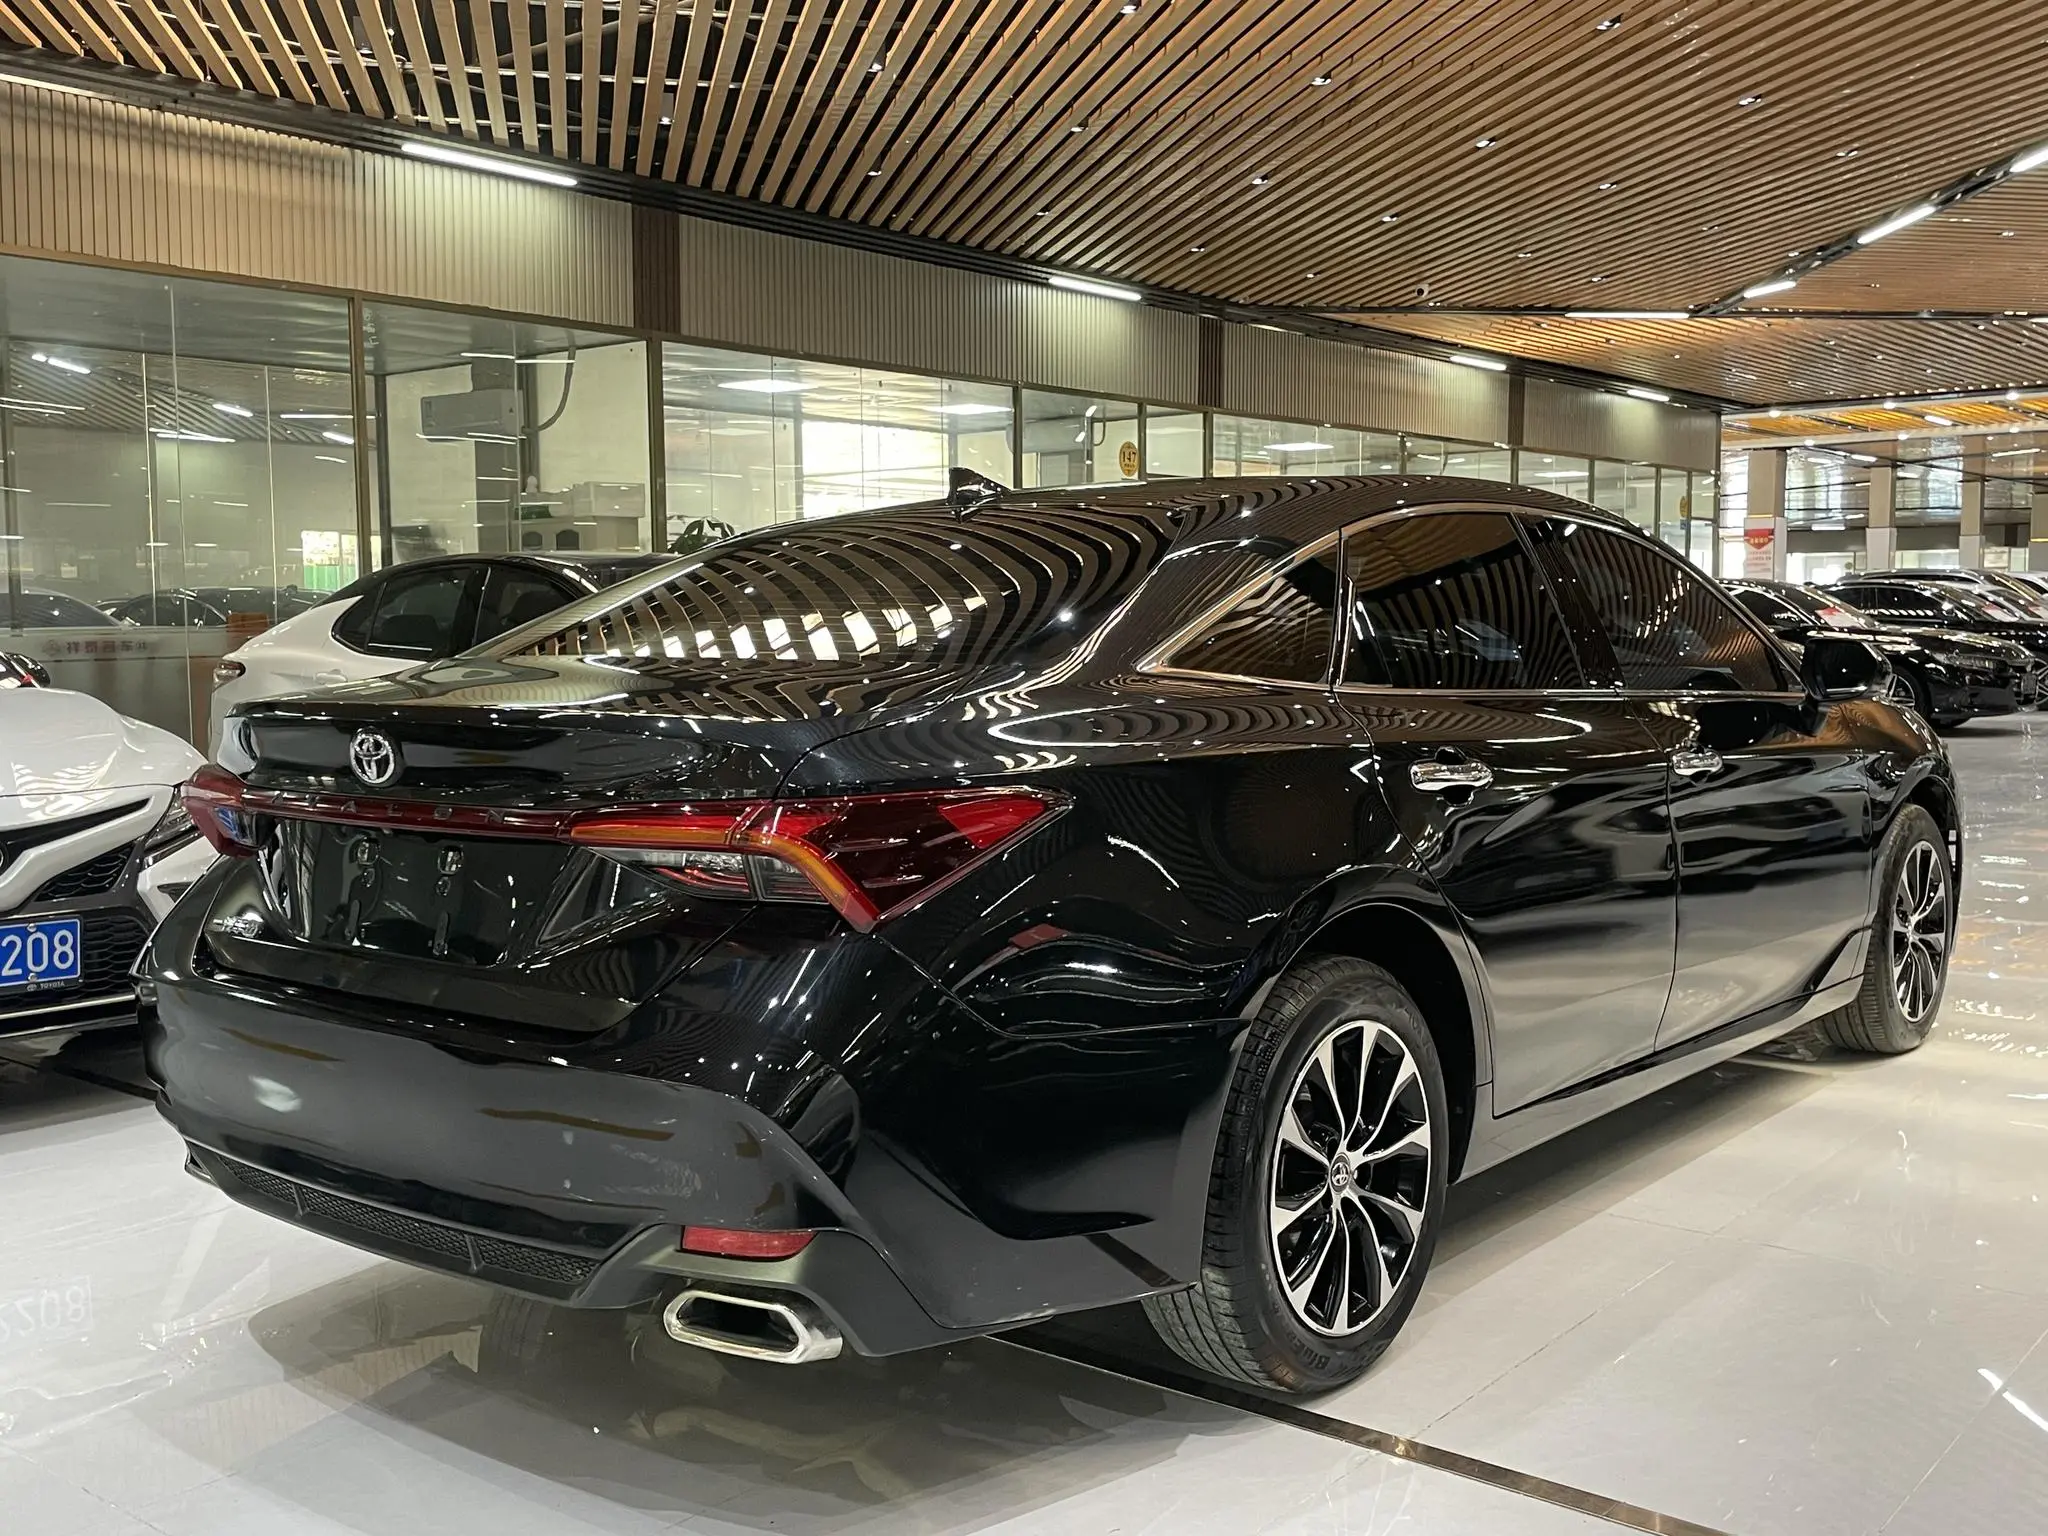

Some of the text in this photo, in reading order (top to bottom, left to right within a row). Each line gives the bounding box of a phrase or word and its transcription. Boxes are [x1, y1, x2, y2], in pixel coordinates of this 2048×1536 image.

[1123, 451, 1136, 462] 147
[271, 791, 504, 824] AVALON
[1, 929, 75, 977] 208
[40, 981, 65, 989] TOYOTA
